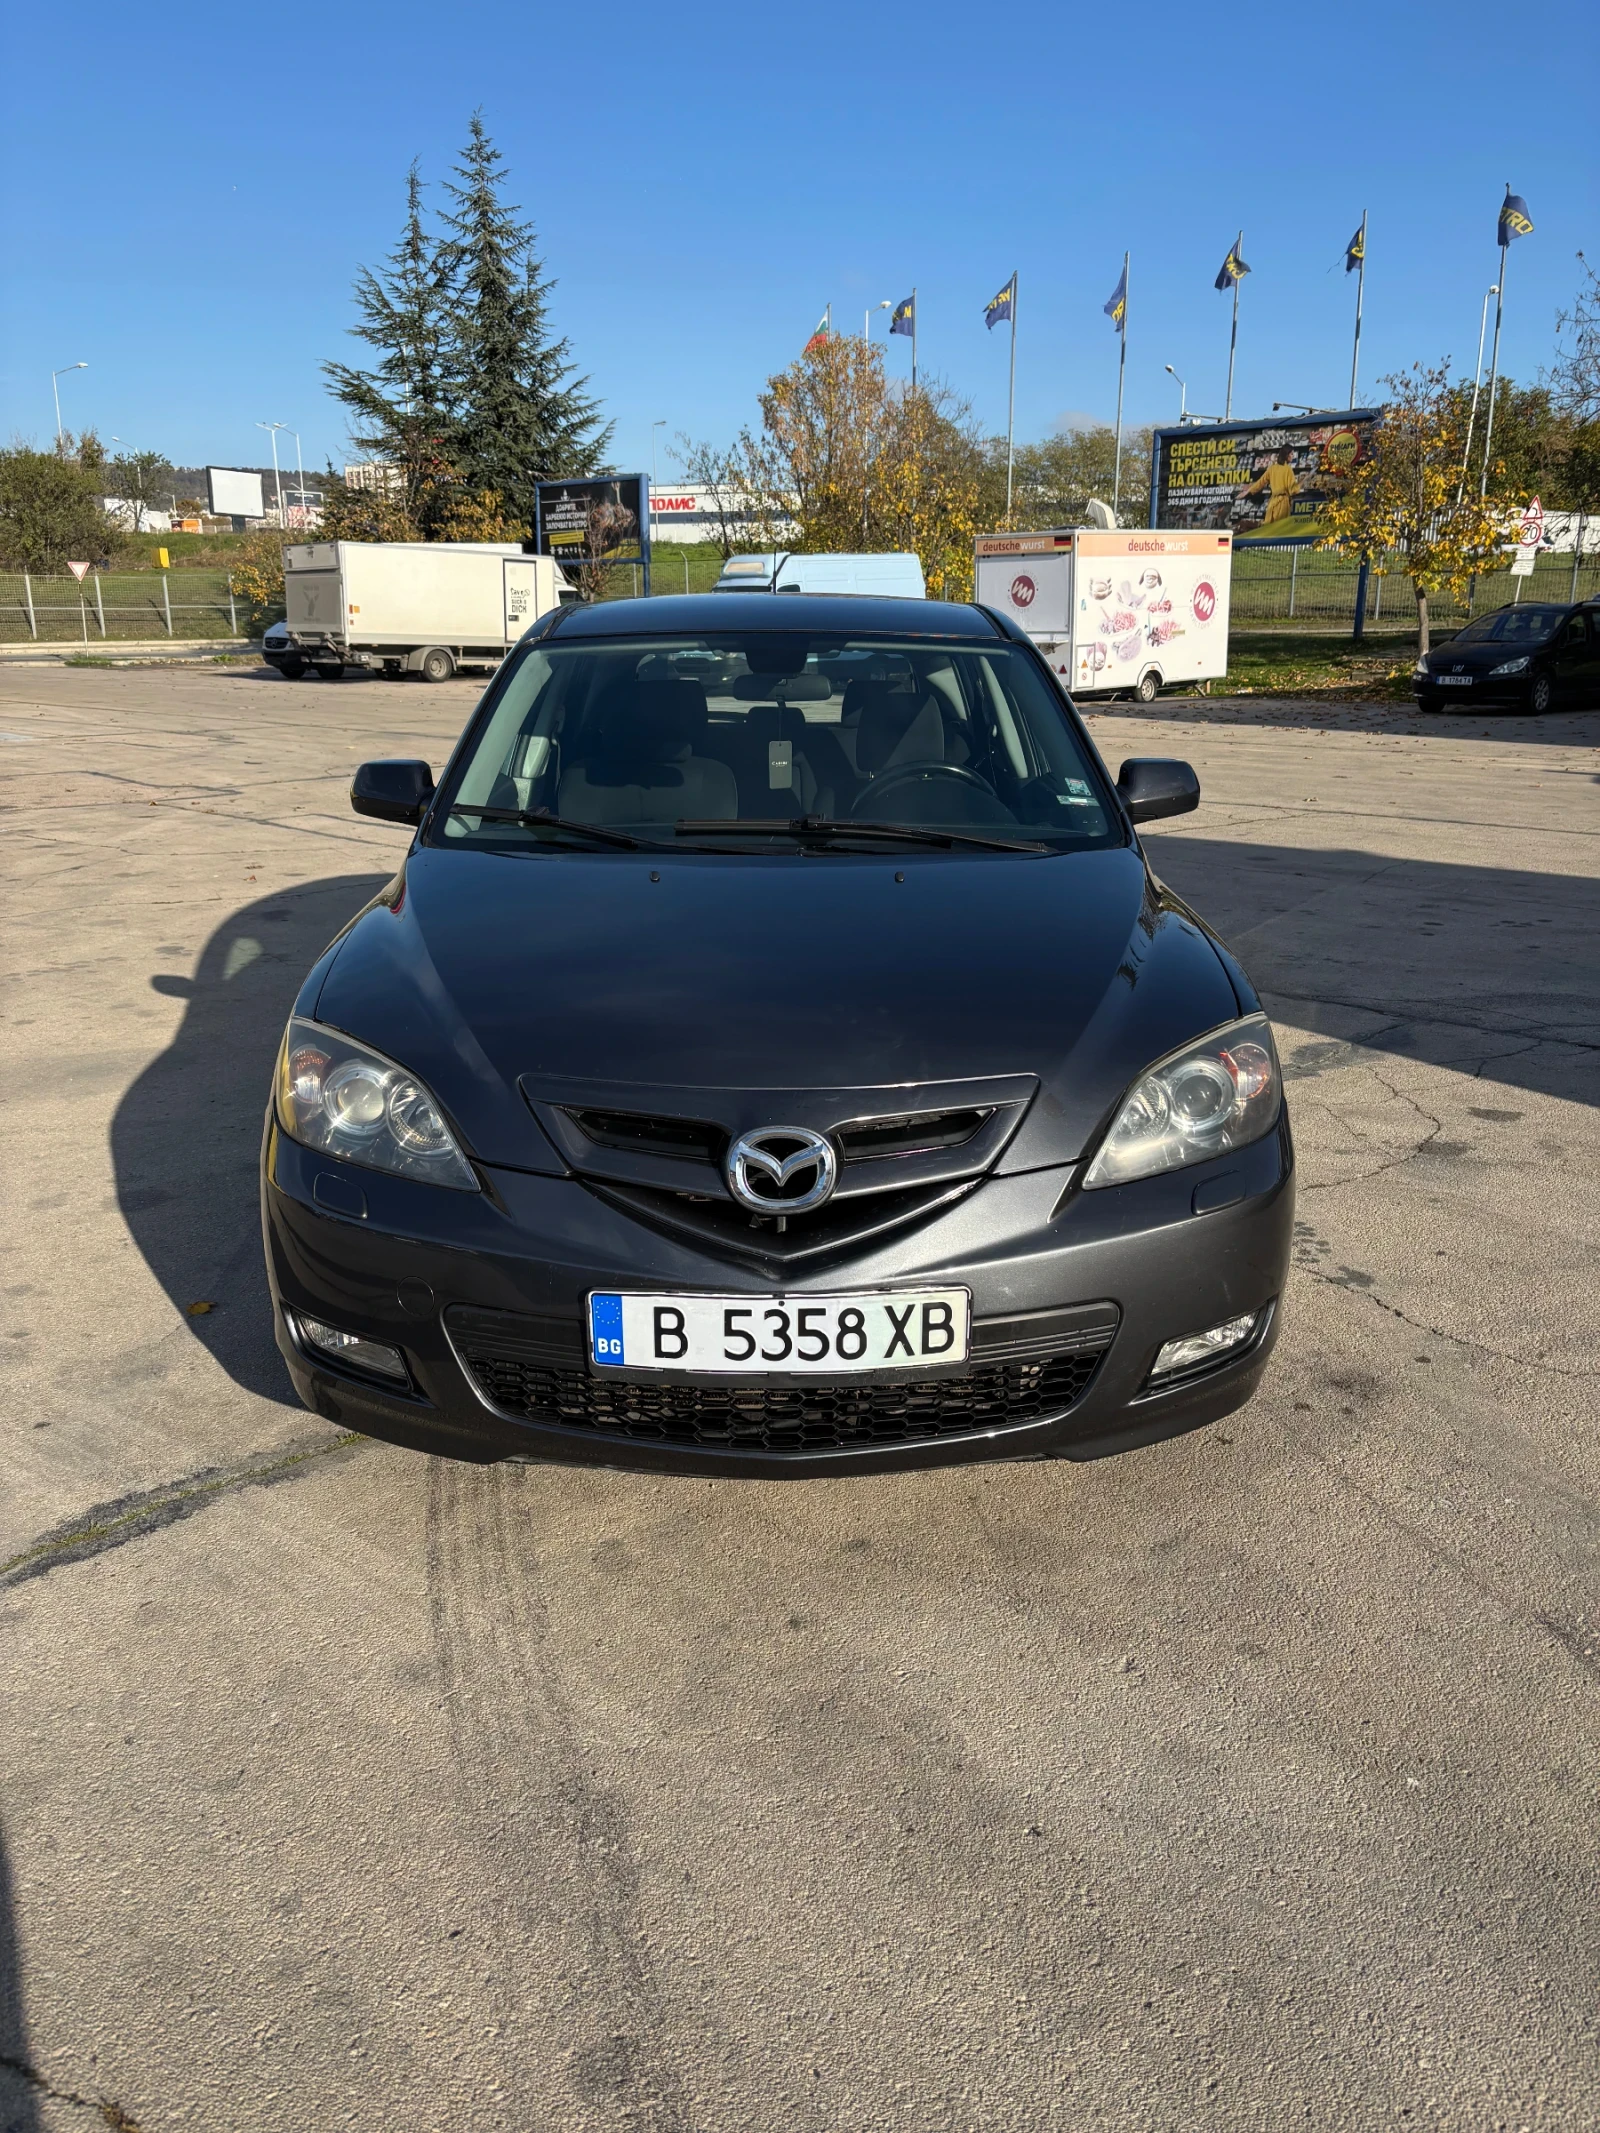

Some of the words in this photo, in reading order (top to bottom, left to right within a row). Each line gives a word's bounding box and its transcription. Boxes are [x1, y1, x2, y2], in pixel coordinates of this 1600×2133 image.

[1218, 439, 1236, 454] СИ
[1169, 454, 1237, 472] ТЪРСЕНЕТО
[1168, 473, 1185, 488] НА
[1187, 469, 1253, 486] ОТСТЪПКИ.
[1167, 498, 1179, 506] 365
[653, 1306, 689, 1359] B
[724, 1308, 867, 1361] 5358
[884, 1302, 955, 1358] XB
[597, 1338, 622, 1354] BG
